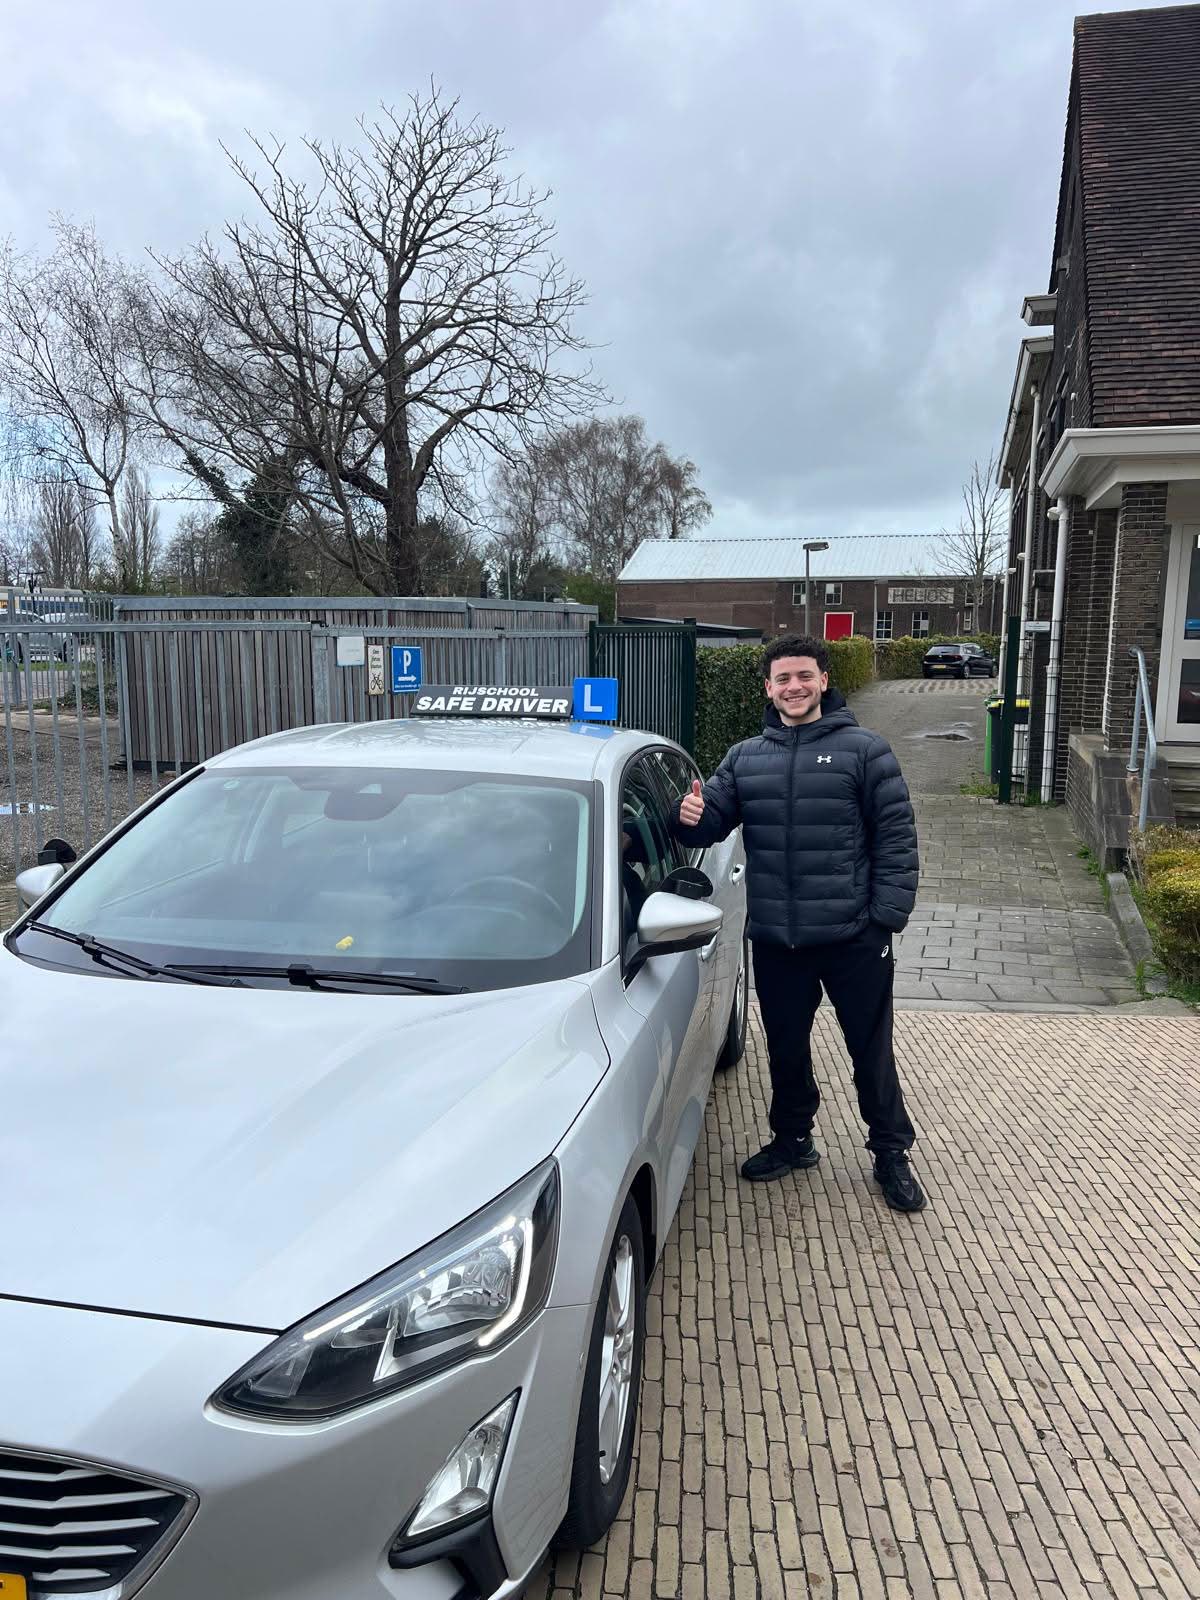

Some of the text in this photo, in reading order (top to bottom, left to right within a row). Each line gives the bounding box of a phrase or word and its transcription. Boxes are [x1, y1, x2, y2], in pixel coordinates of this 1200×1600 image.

[403, 650, 412, 674] P
[452, 686, 539, 697] RIJSCHOOL
[583, 684, 603, 712] L
[416, 696, 569, 713] SAFE DRIVER
